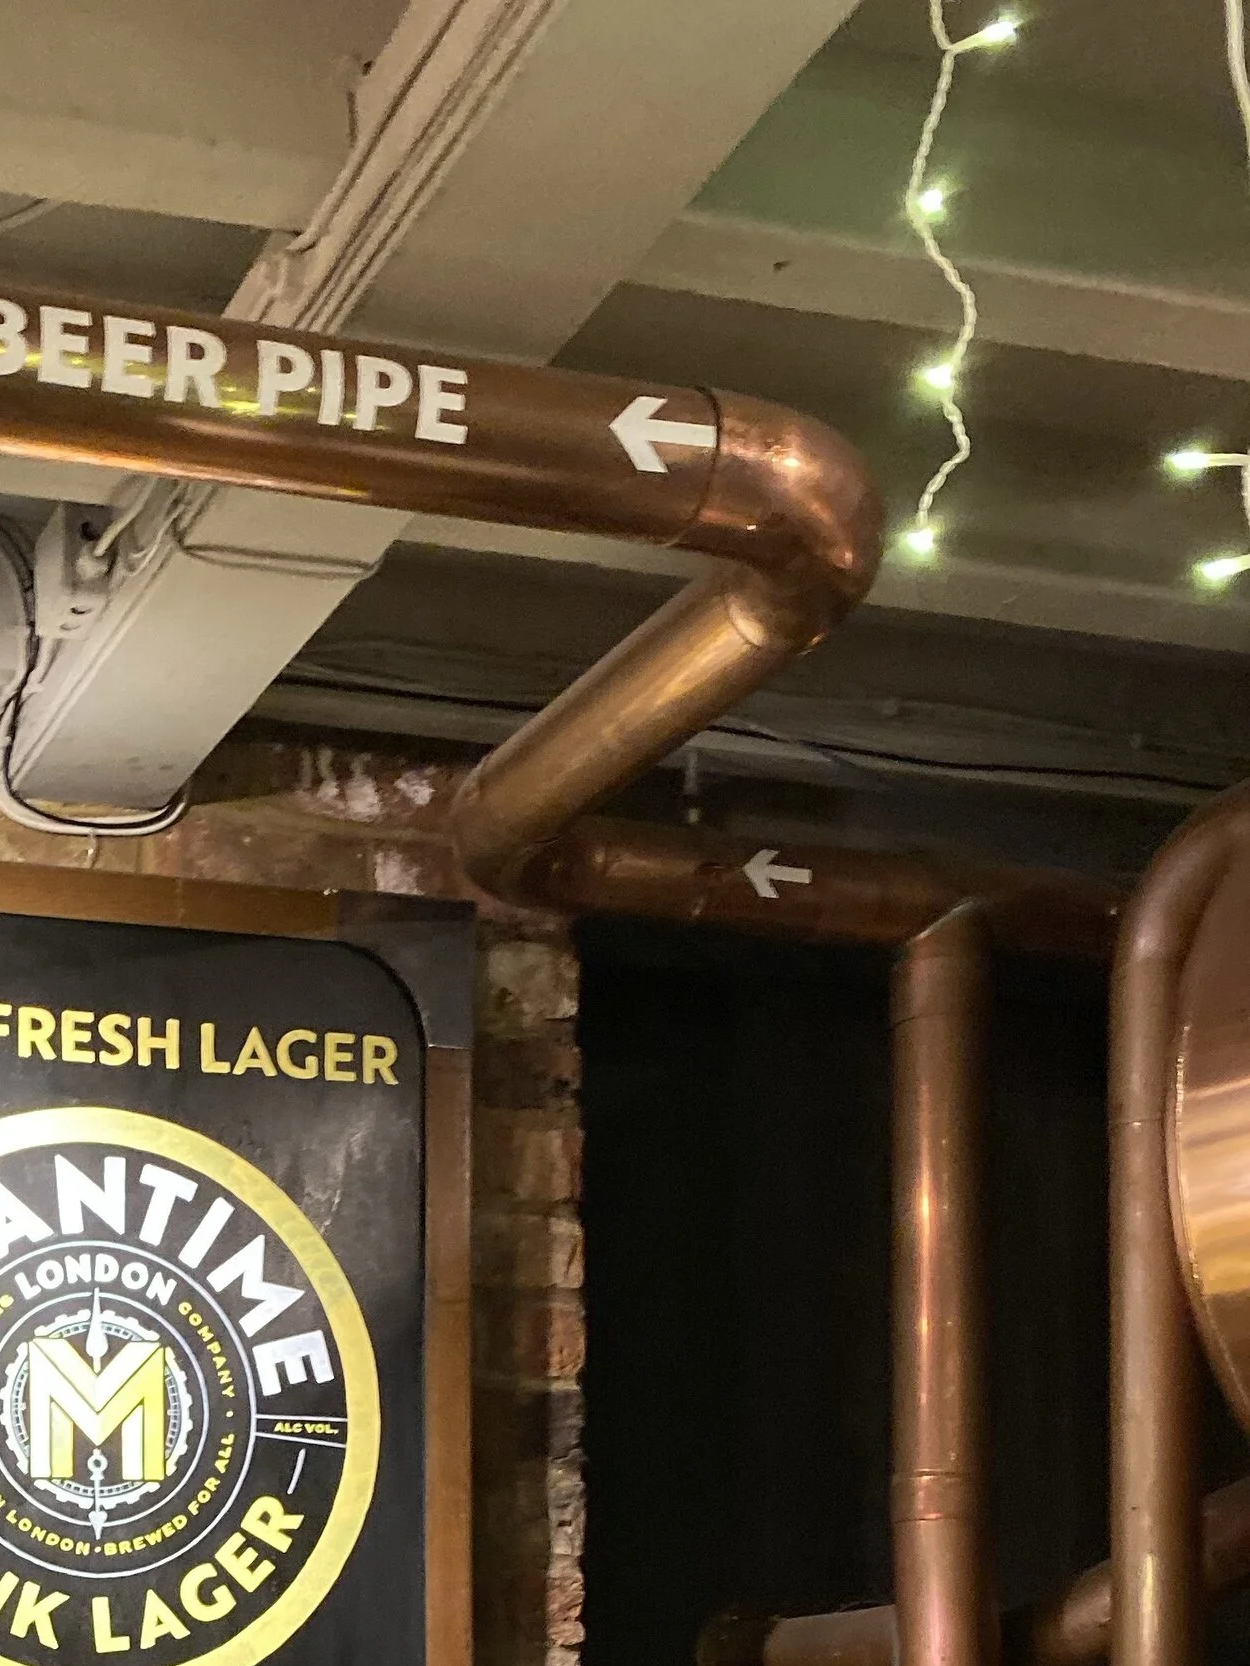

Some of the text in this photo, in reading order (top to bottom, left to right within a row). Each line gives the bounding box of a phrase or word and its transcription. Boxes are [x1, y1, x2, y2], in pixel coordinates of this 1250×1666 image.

[256, 340, 469, 446] PIPE
[199, 1022, 399, 1086] LAGER
[15, 1253, 178, 1305] LONDON
[178, 1302, 236, 1398] COMPANY
[273, 1421, 304, 1434] ALC
[5, 1509, 91, 1556] LONDON
[104, 1433, 236, 1557] BREWED FOR ALL
[91, 1495, 306, 1654] LAGER
